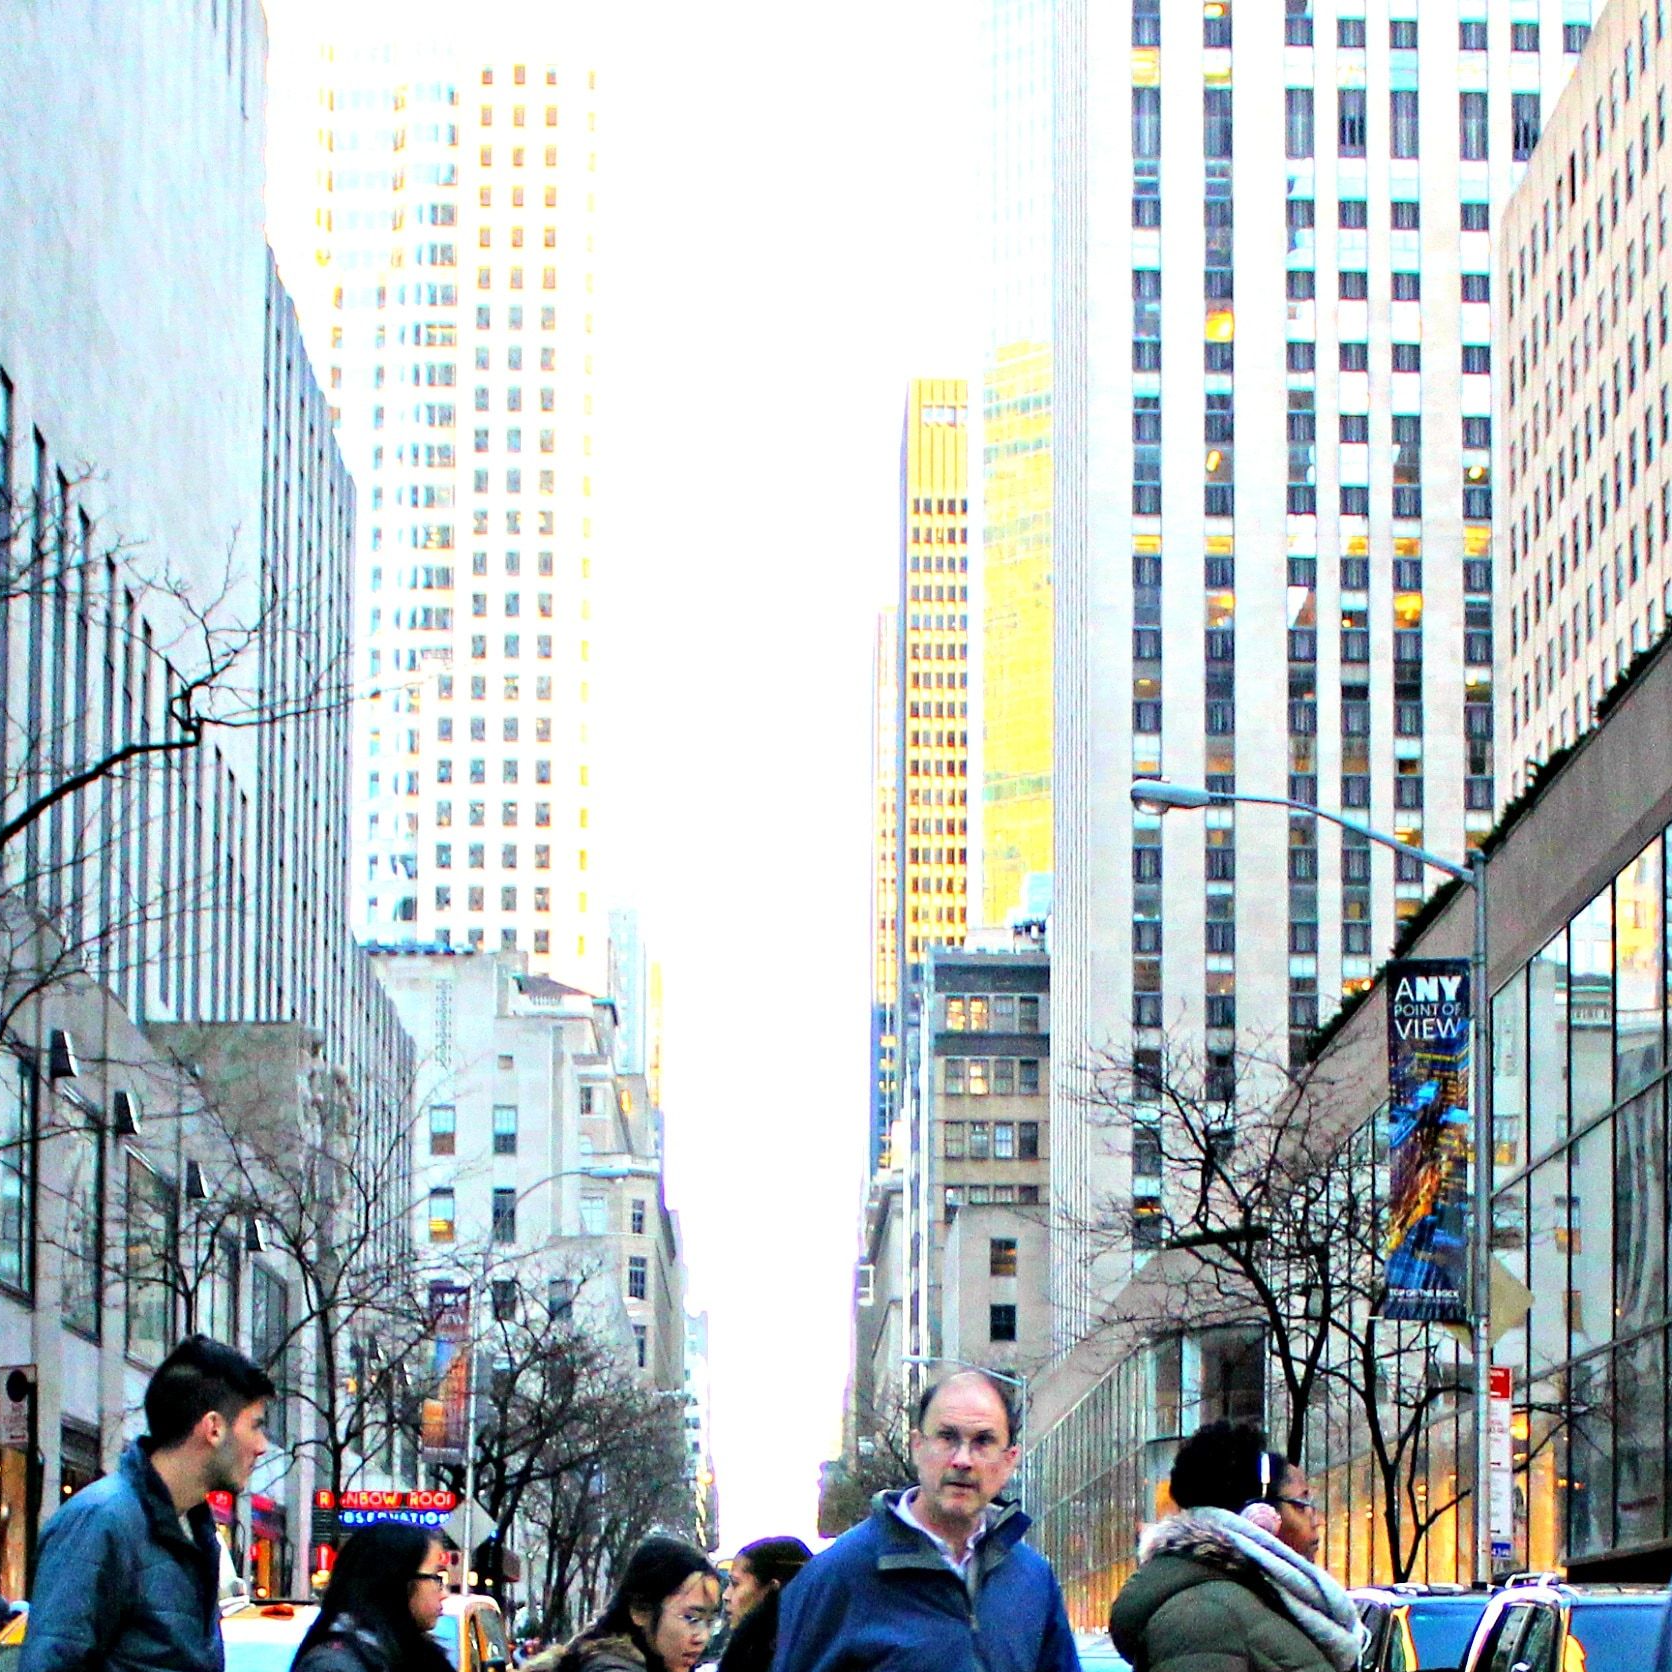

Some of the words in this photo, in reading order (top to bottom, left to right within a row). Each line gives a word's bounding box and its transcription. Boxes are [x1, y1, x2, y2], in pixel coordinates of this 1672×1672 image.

[1394, 974, 1463, 1002] ANY
[1394, 1003, 1437, 1018] POINT
[1441, 1003, 1462, 1016] OF
[1395, 1018, 1461, 1040] VIEW
[319, 1491, 398, 1506] RNBOW
